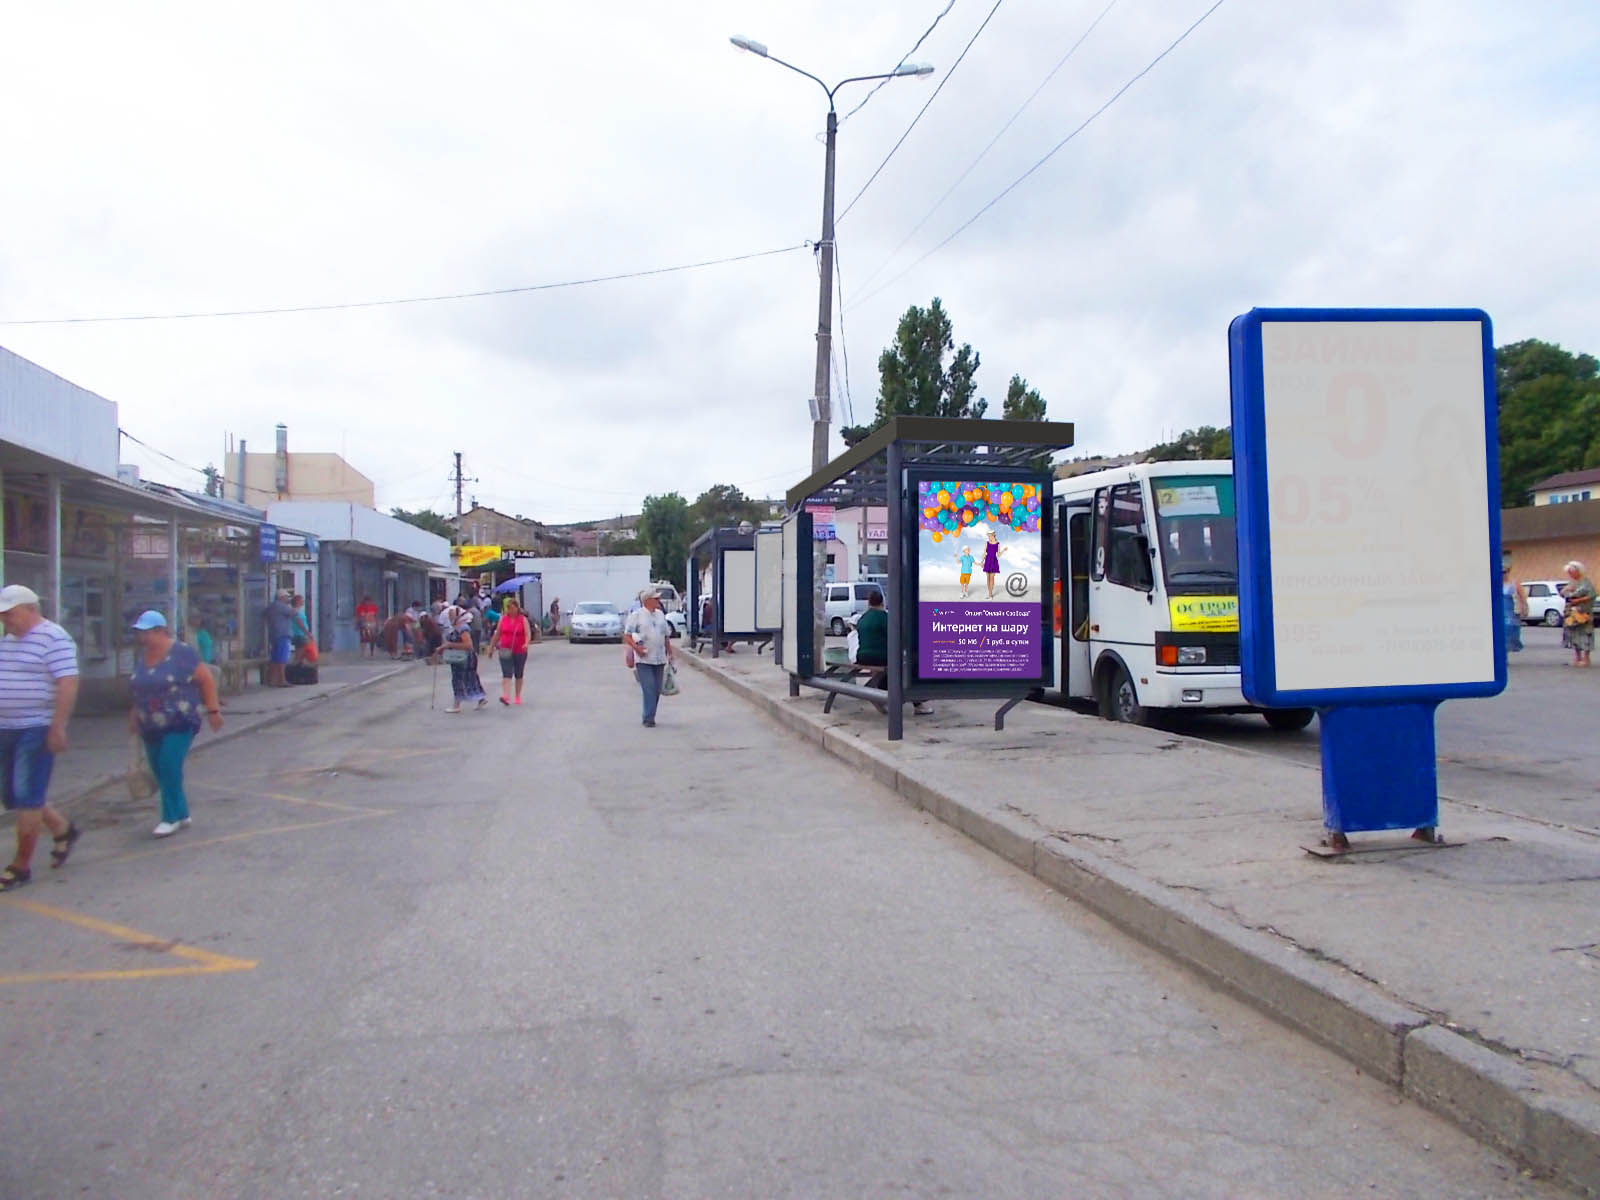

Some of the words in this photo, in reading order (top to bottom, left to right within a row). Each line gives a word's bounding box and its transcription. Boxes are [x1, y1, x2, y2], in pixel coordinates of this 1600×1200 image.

[932, 621, 983, 635] Интернет
[985, 624, 998, 632] на
[1001, 624, 1029, 635] шару
